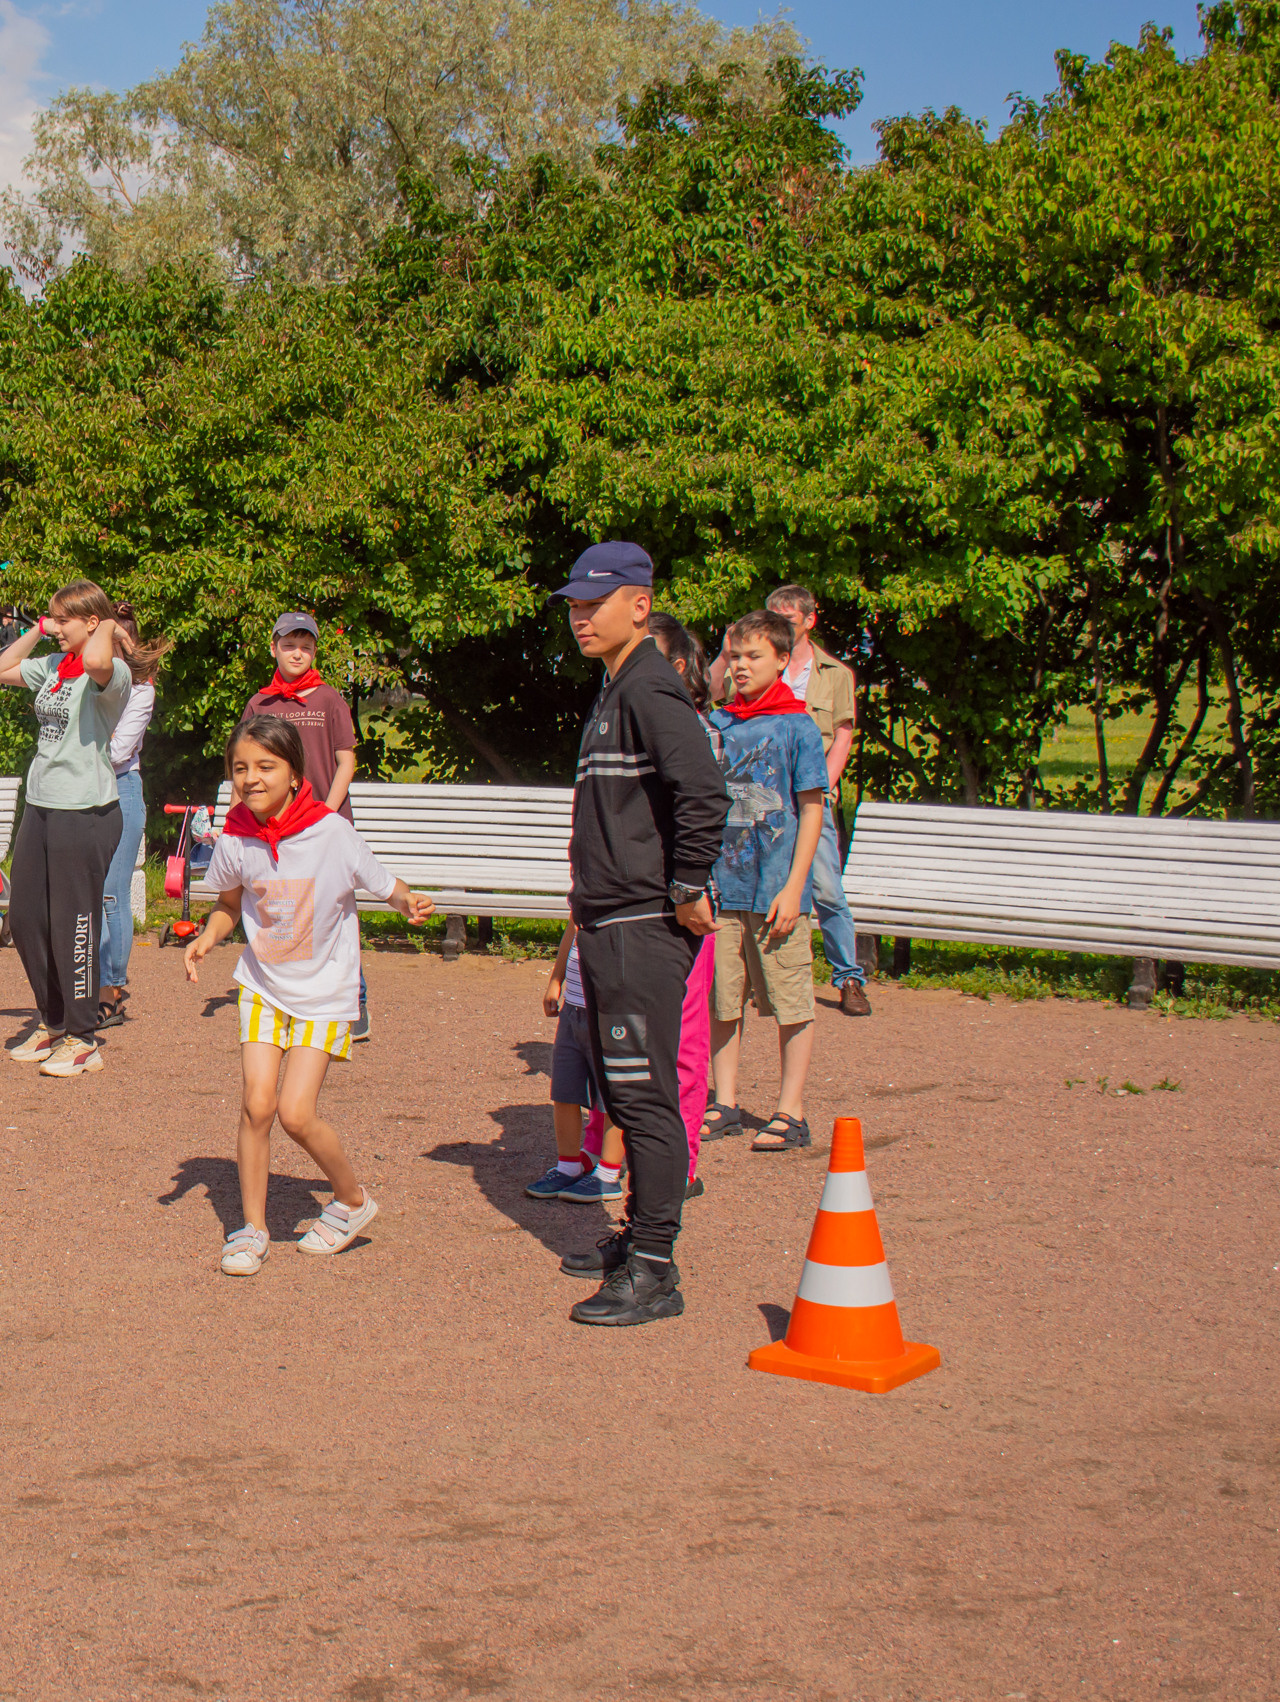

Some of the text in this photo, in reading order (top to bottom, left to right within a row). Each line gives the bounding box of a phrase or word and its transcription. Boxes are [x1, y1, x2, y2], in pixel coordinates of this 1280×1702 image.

[285, 711, 306, 719] LOOK
[307, 710, 326, 718] BACK
[73, 913, 89, 1000] FILA SPORT
